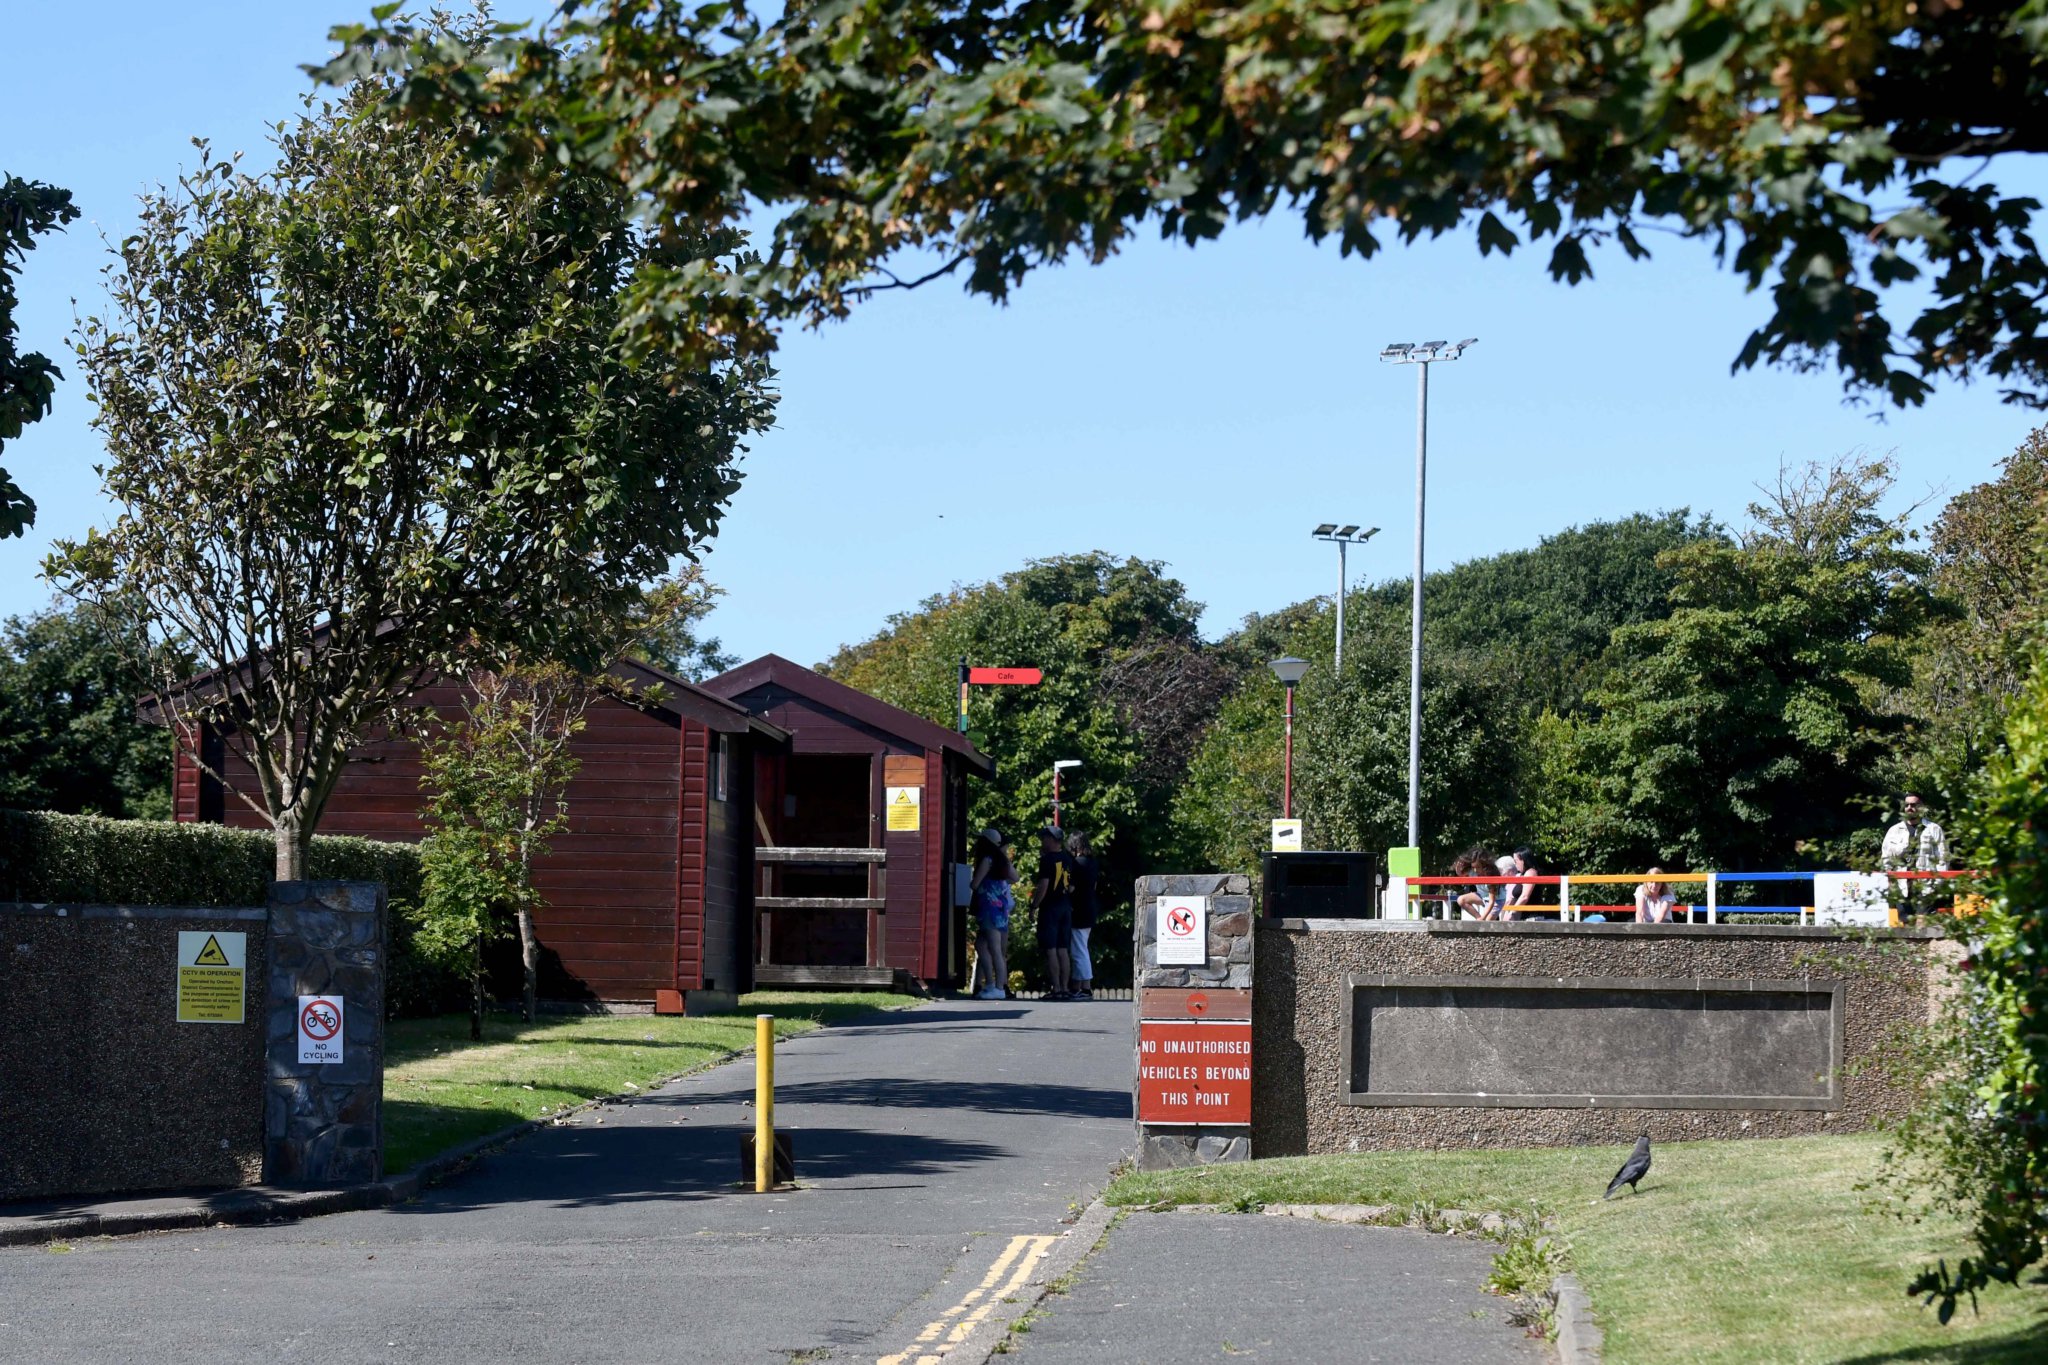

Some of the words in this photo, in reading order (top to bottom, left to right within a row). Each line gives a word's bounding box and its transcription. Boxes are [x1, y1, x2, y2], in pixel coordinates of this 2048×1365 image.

[997, 672, 1014, 680] Cafe
[1141, 1041, 1156, 1054] NO
[1164, 1041, 1250, 1055] UNAUTHORISED
[1141, 1066, 1197, 1080] VEHICLES
[1206, 1066, 1250, 1080] BEYOND
[1161, 1092, 1188, 1106] THIS
[1195, 1093, 1230, 1106] POINT
